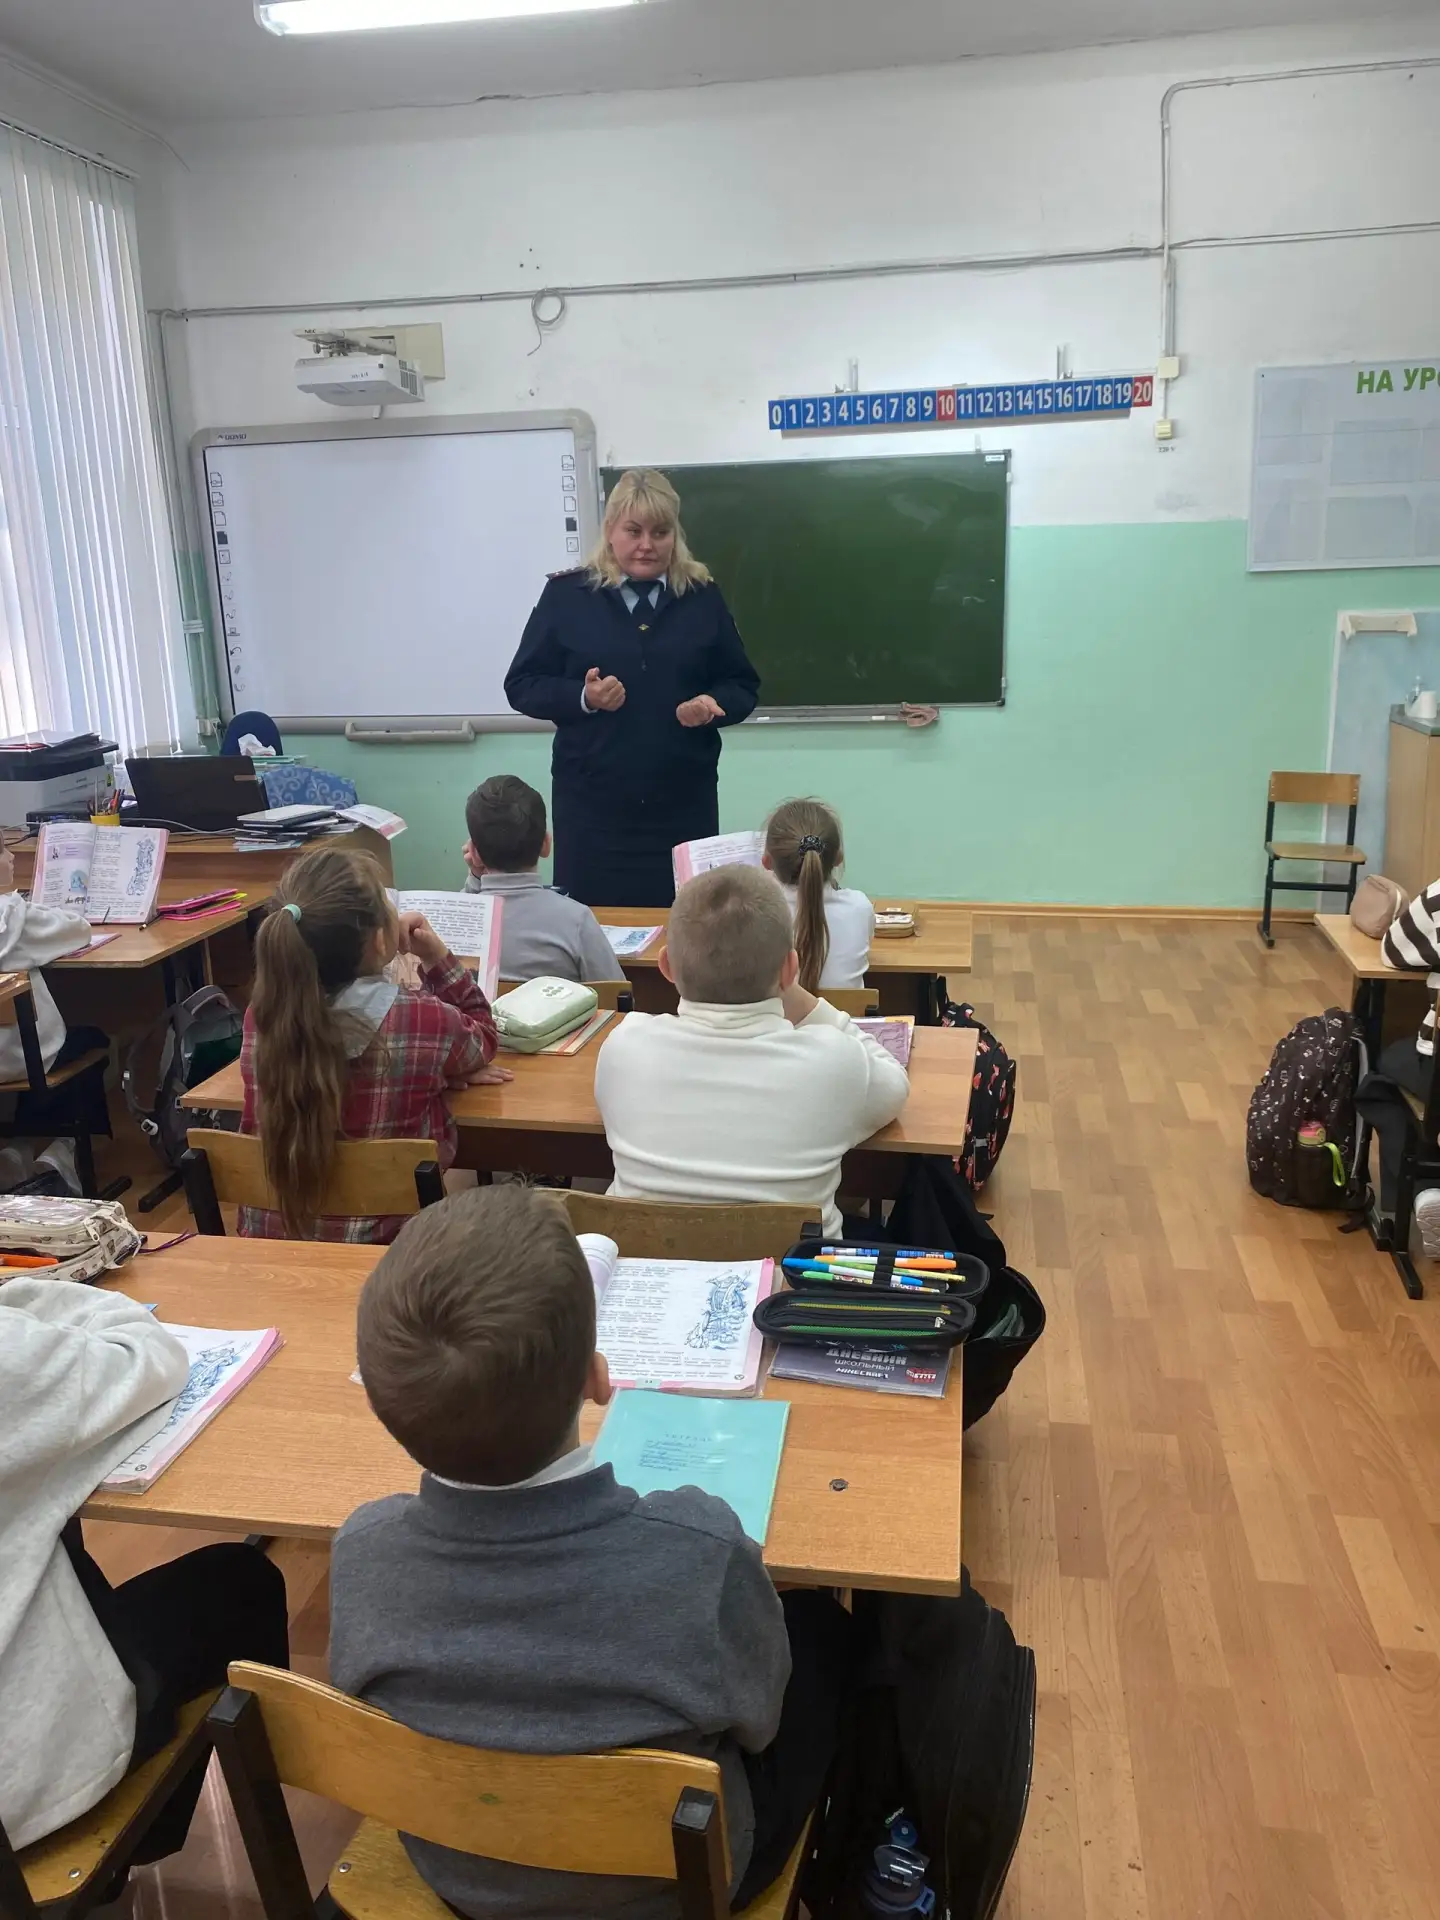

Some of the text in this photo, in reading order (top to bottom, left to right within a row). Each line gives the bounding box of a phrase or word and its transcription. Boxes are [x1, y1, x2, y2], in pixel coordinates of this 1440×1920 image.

[1356, 369, 1394, 394] НА
[772, 381, 1151, 425] 0 1 2 3 4 5 6 7 8 9 10 11 12 13 14 15 16 17 18 19 20
[826, 1348, 908, 1366] ДНЕВНИК
[834, 1359, 895, 1372] ШКОЛЬНЫЙ
[835, 1367, 889, 1379] MINECRAFT
